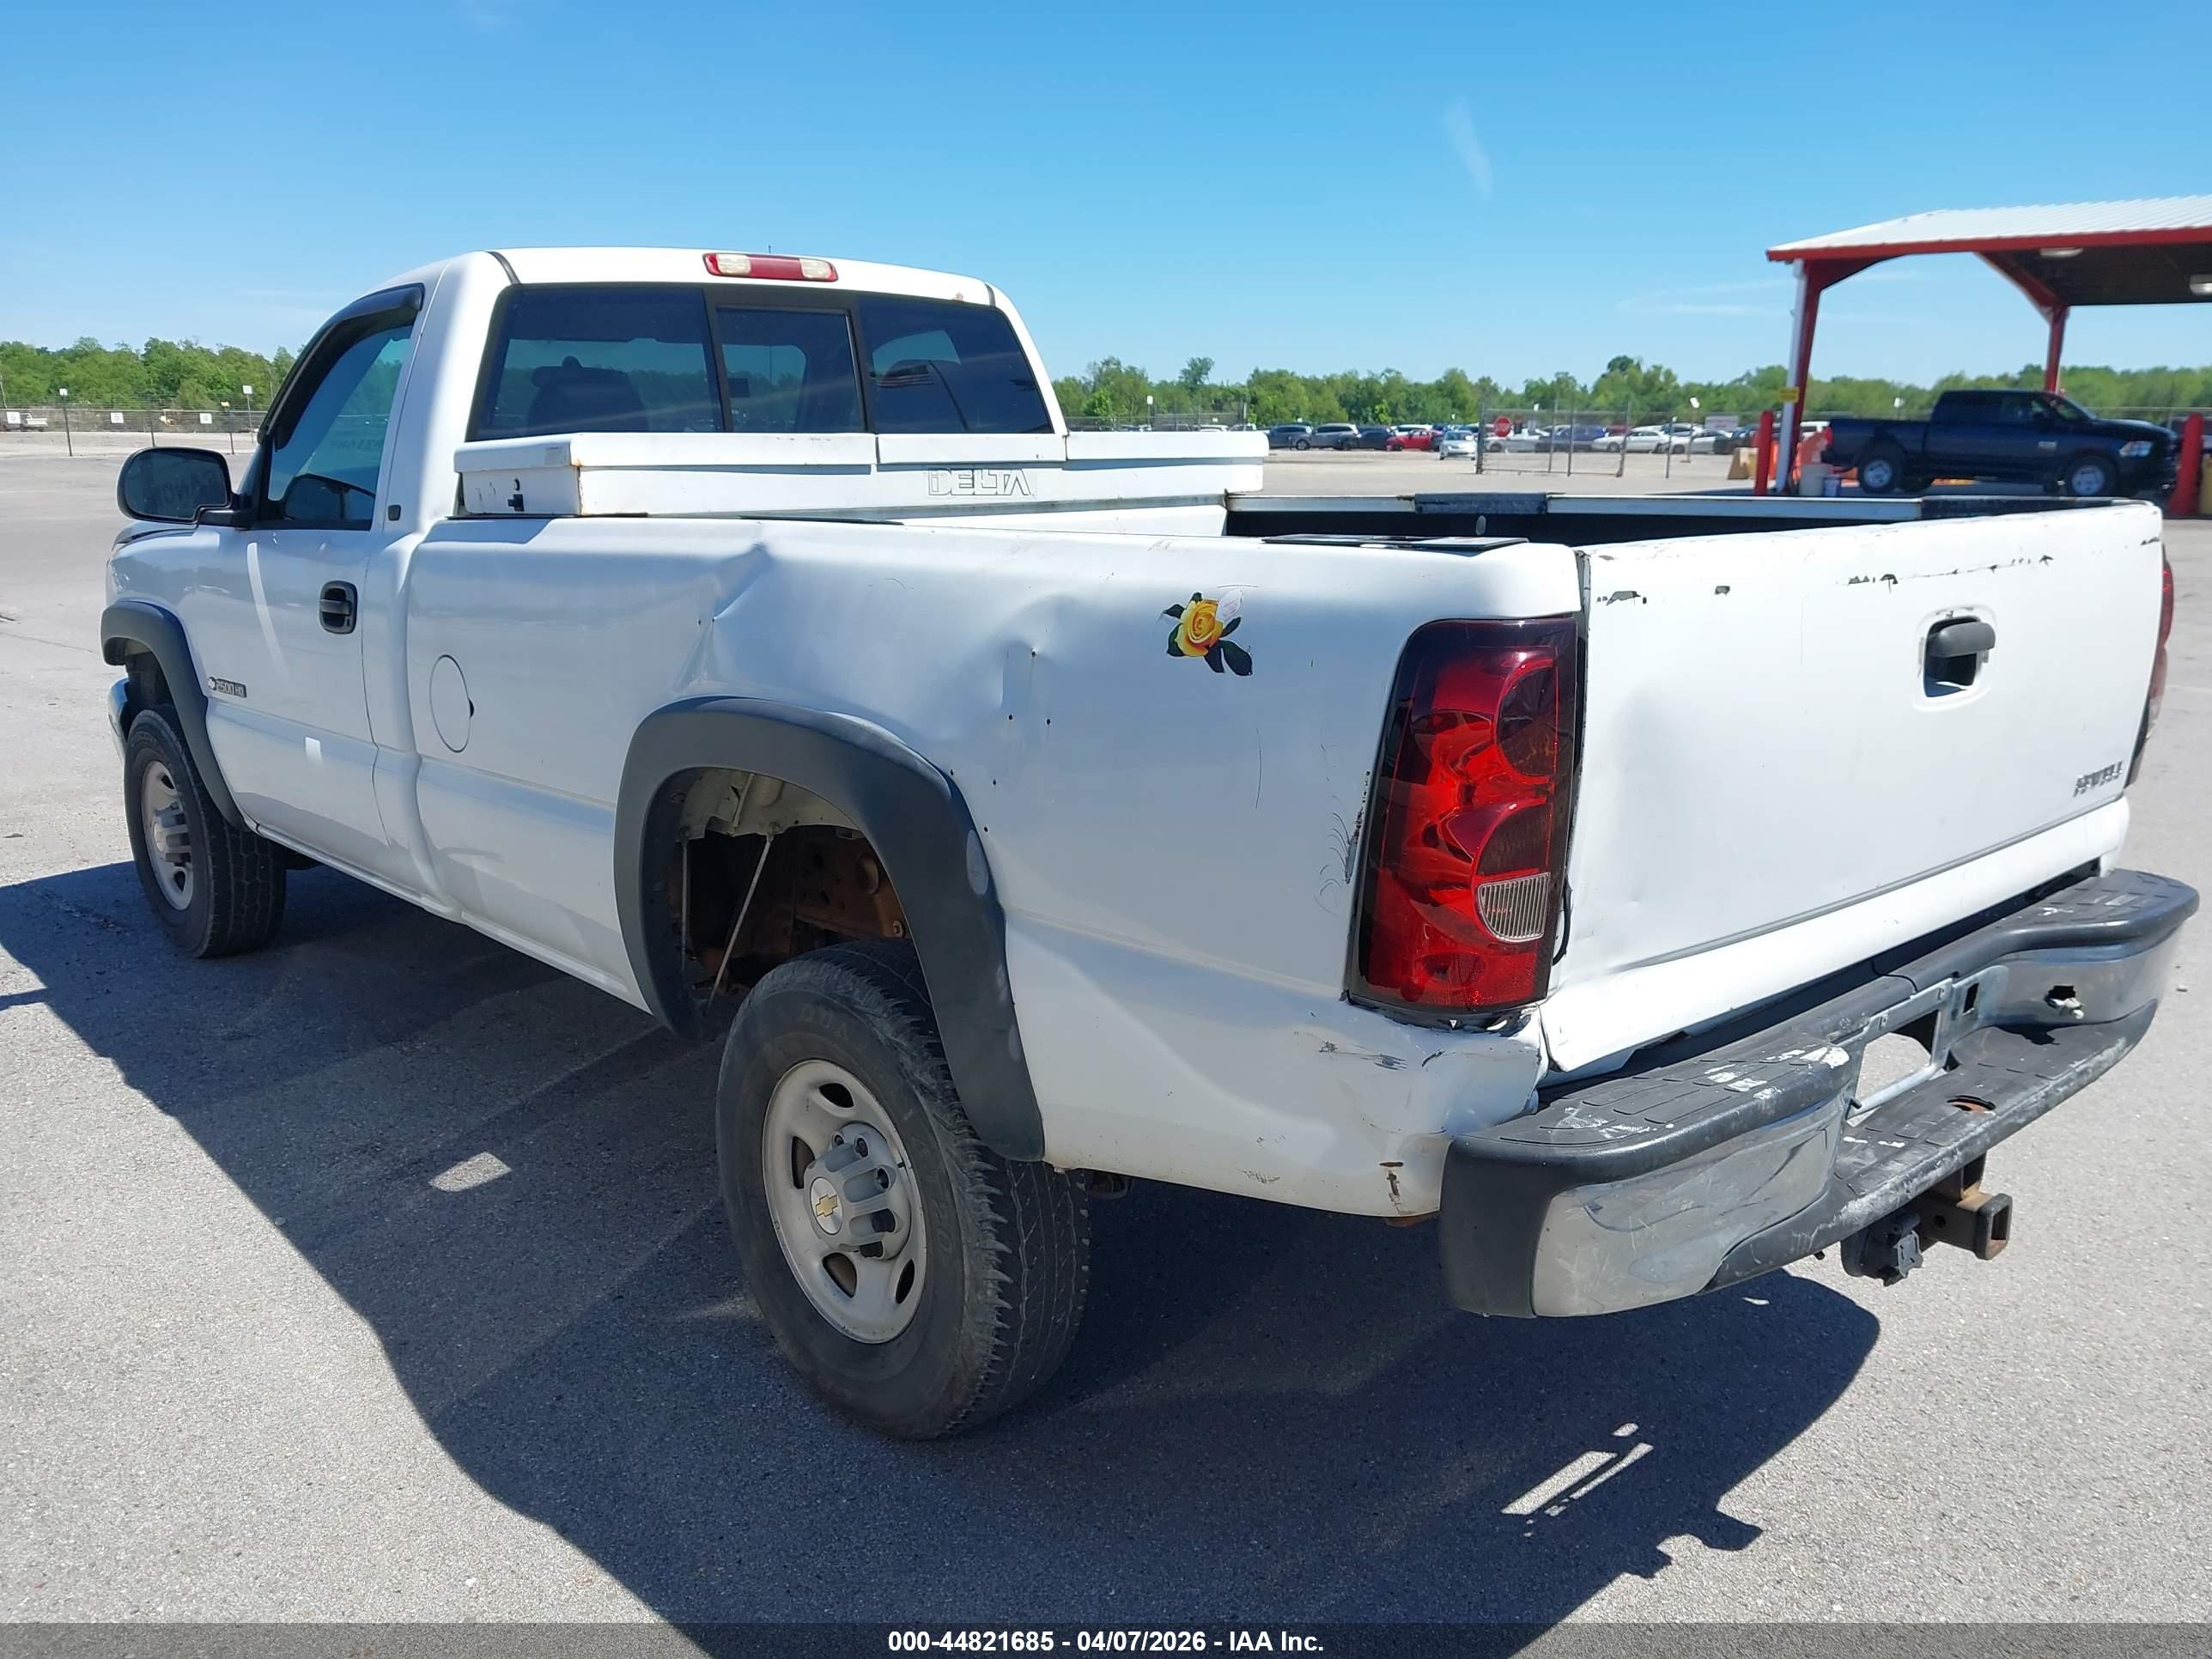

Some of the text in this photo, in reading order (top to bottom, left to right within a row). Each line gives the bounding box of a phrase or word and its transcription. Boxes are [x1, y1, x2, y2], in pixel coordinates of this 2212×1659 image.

[927, 468, 1031, 496] DELTA
[216, 680, 244, 696] 2500 HD
